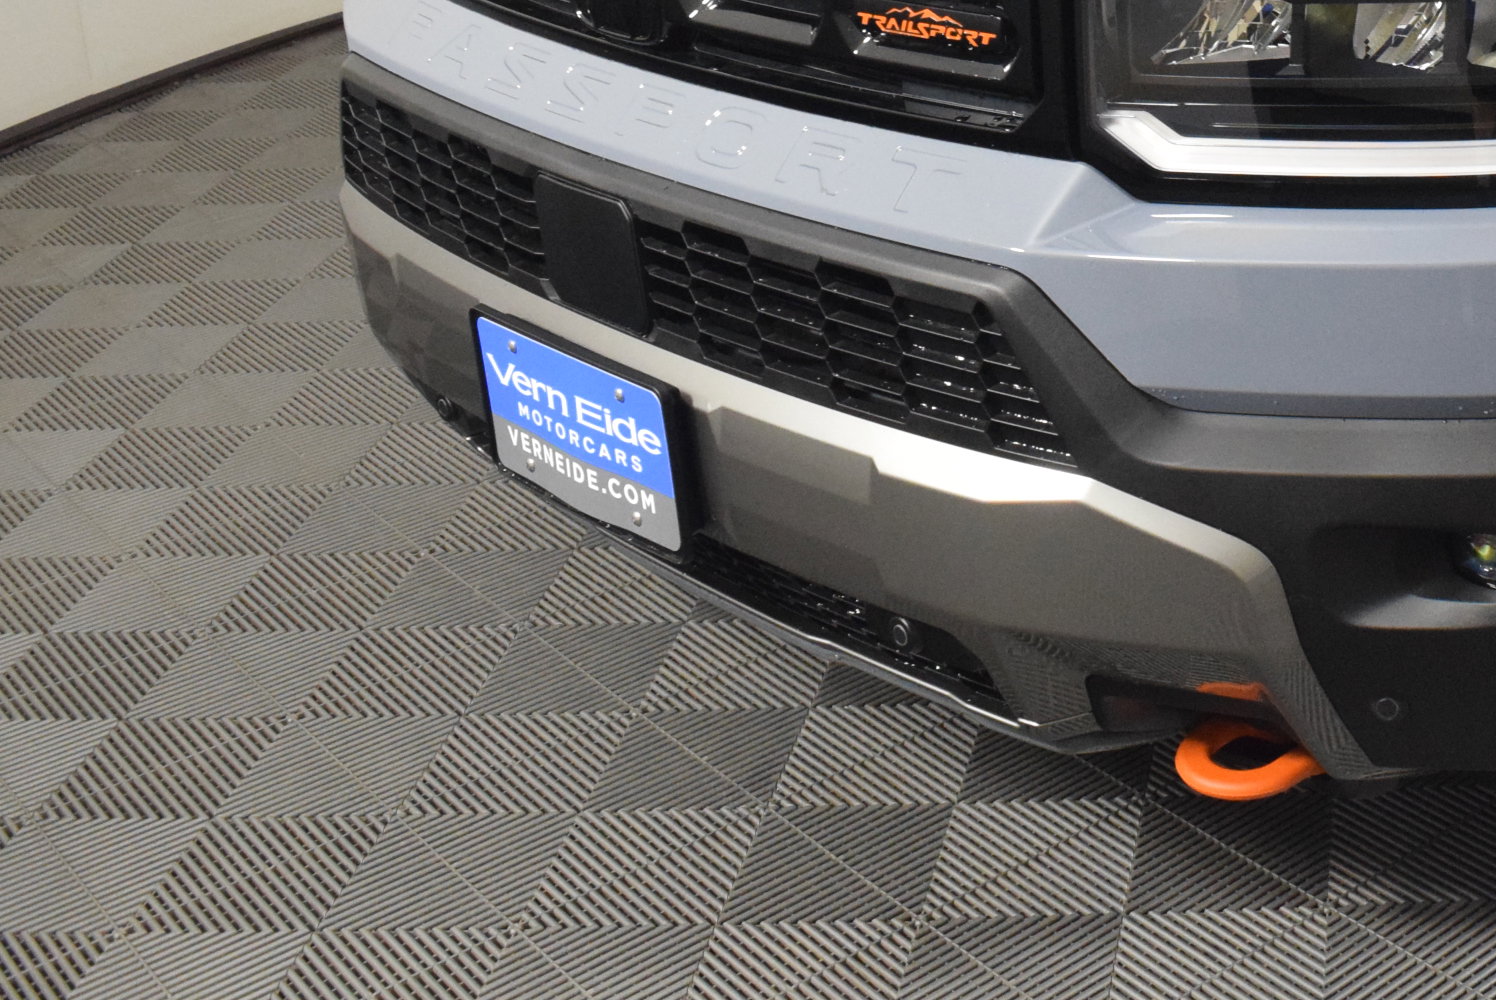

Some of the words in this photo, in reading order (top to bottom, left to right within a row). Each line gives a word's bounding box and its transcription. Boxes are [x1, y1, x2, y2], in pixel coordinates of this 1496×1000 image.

[857, 11, 997, 47] TRAILSPORT
[386, 0, 967, 214] PASSPORT
[486, 352, 570, 418] Vern
[573, 395, 662, 455] Eide
[517, 401, 643, 473] MOTORCARS
[507, 425, 656, 514] VERNEIDE.COM
